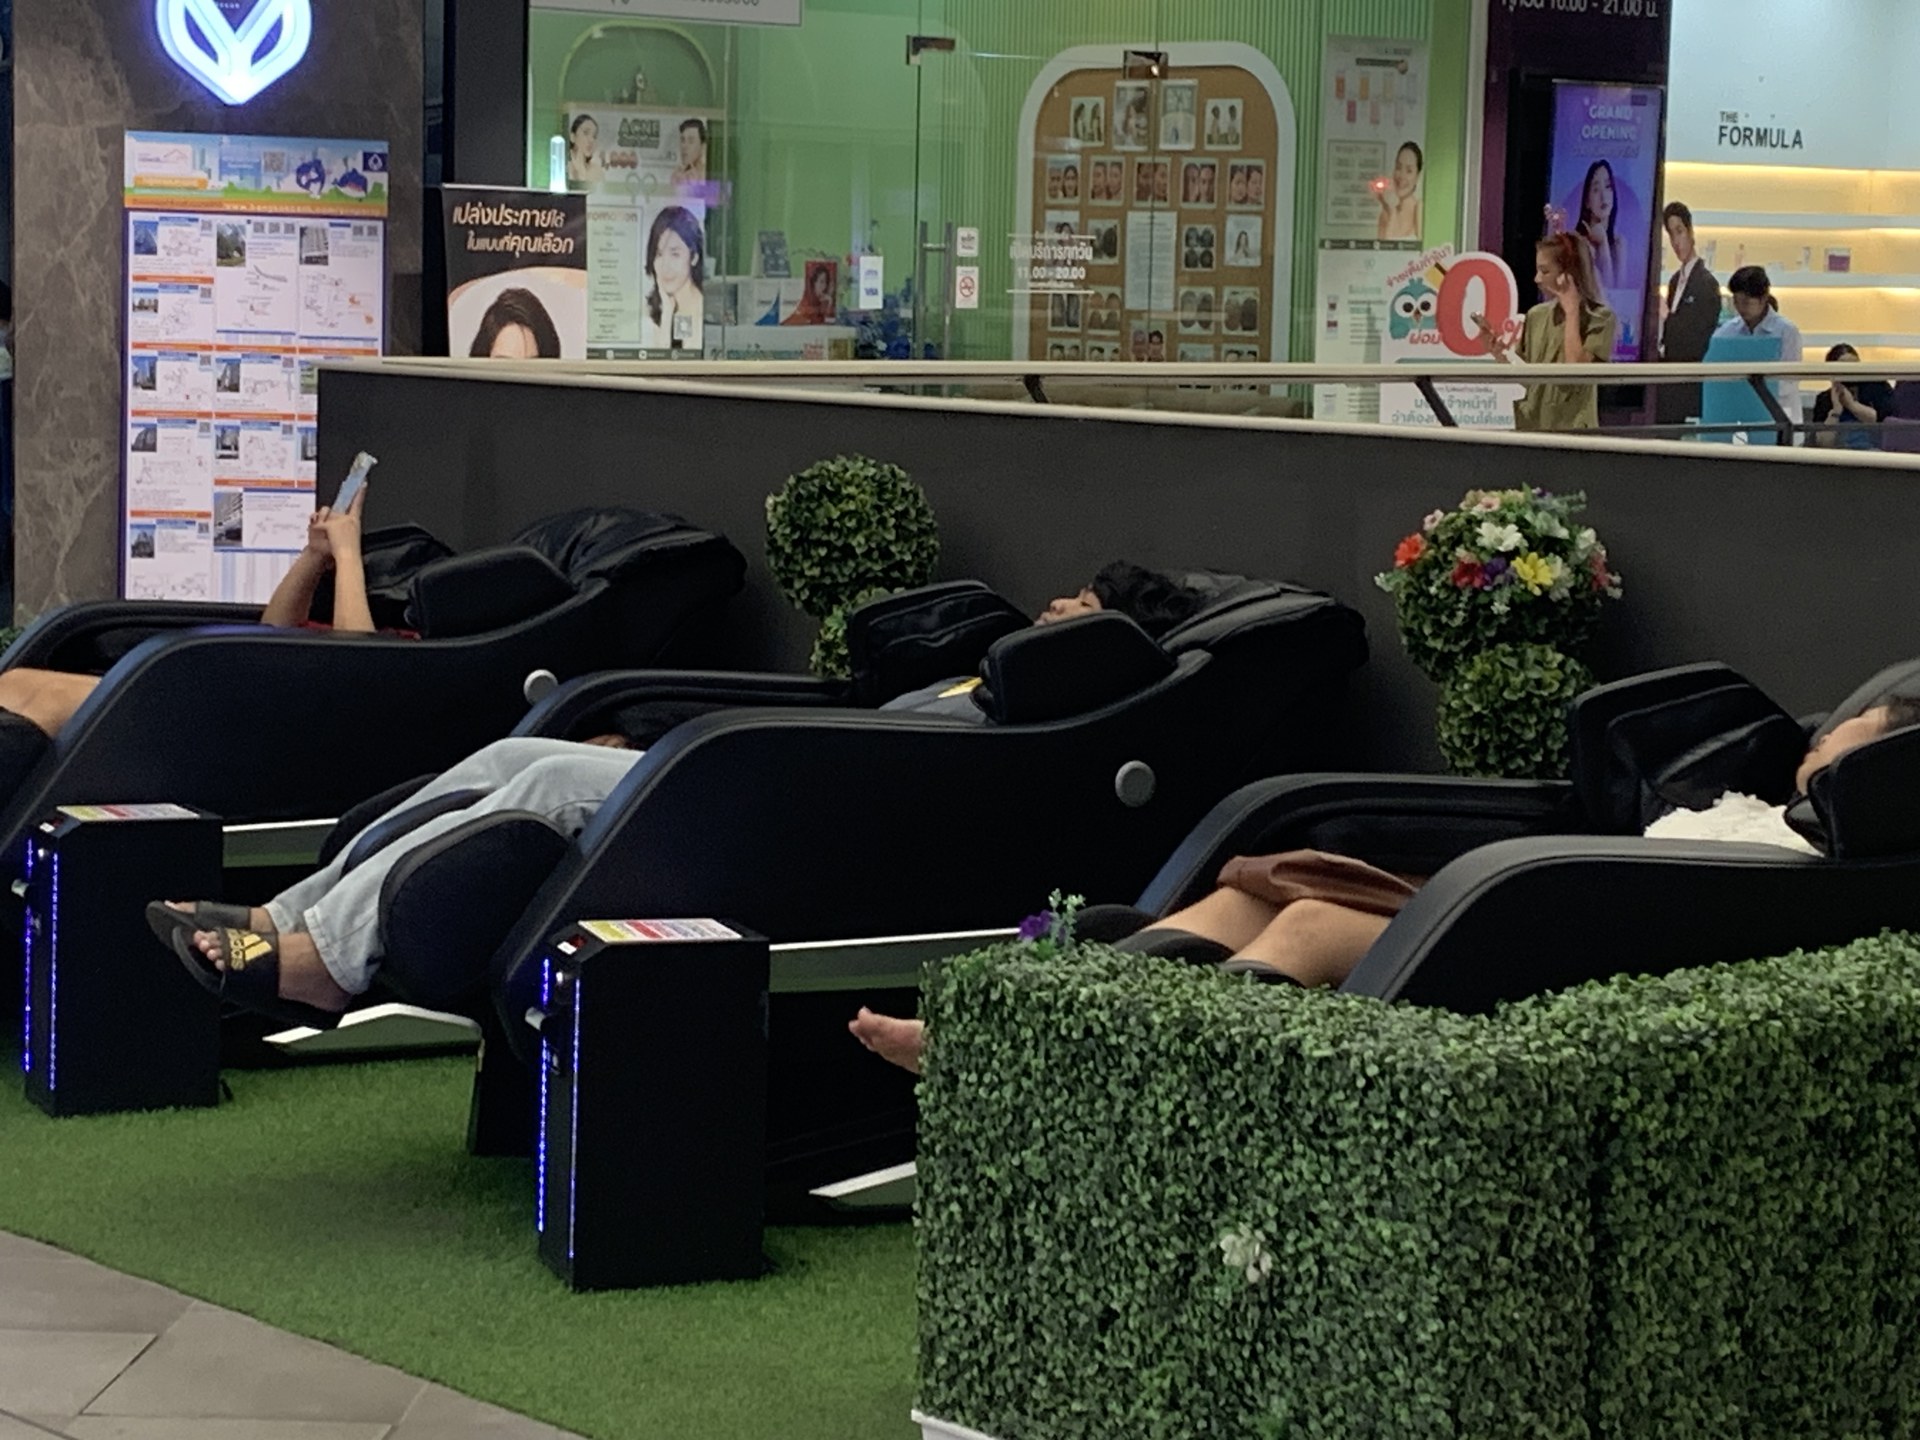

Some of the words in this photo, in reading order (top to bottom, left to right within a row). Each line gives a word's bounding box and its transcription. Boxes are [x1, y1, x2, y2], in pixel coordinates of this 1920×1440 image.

[1603, 0, 1643, 16] 21.00
[1589, 105, 1632, 119] GRAND
[1720, 111, 1738, 123] THE
[1581, 125, 1636, 140] OPENING
[1718, 125, 1803, 149] FORMULA
